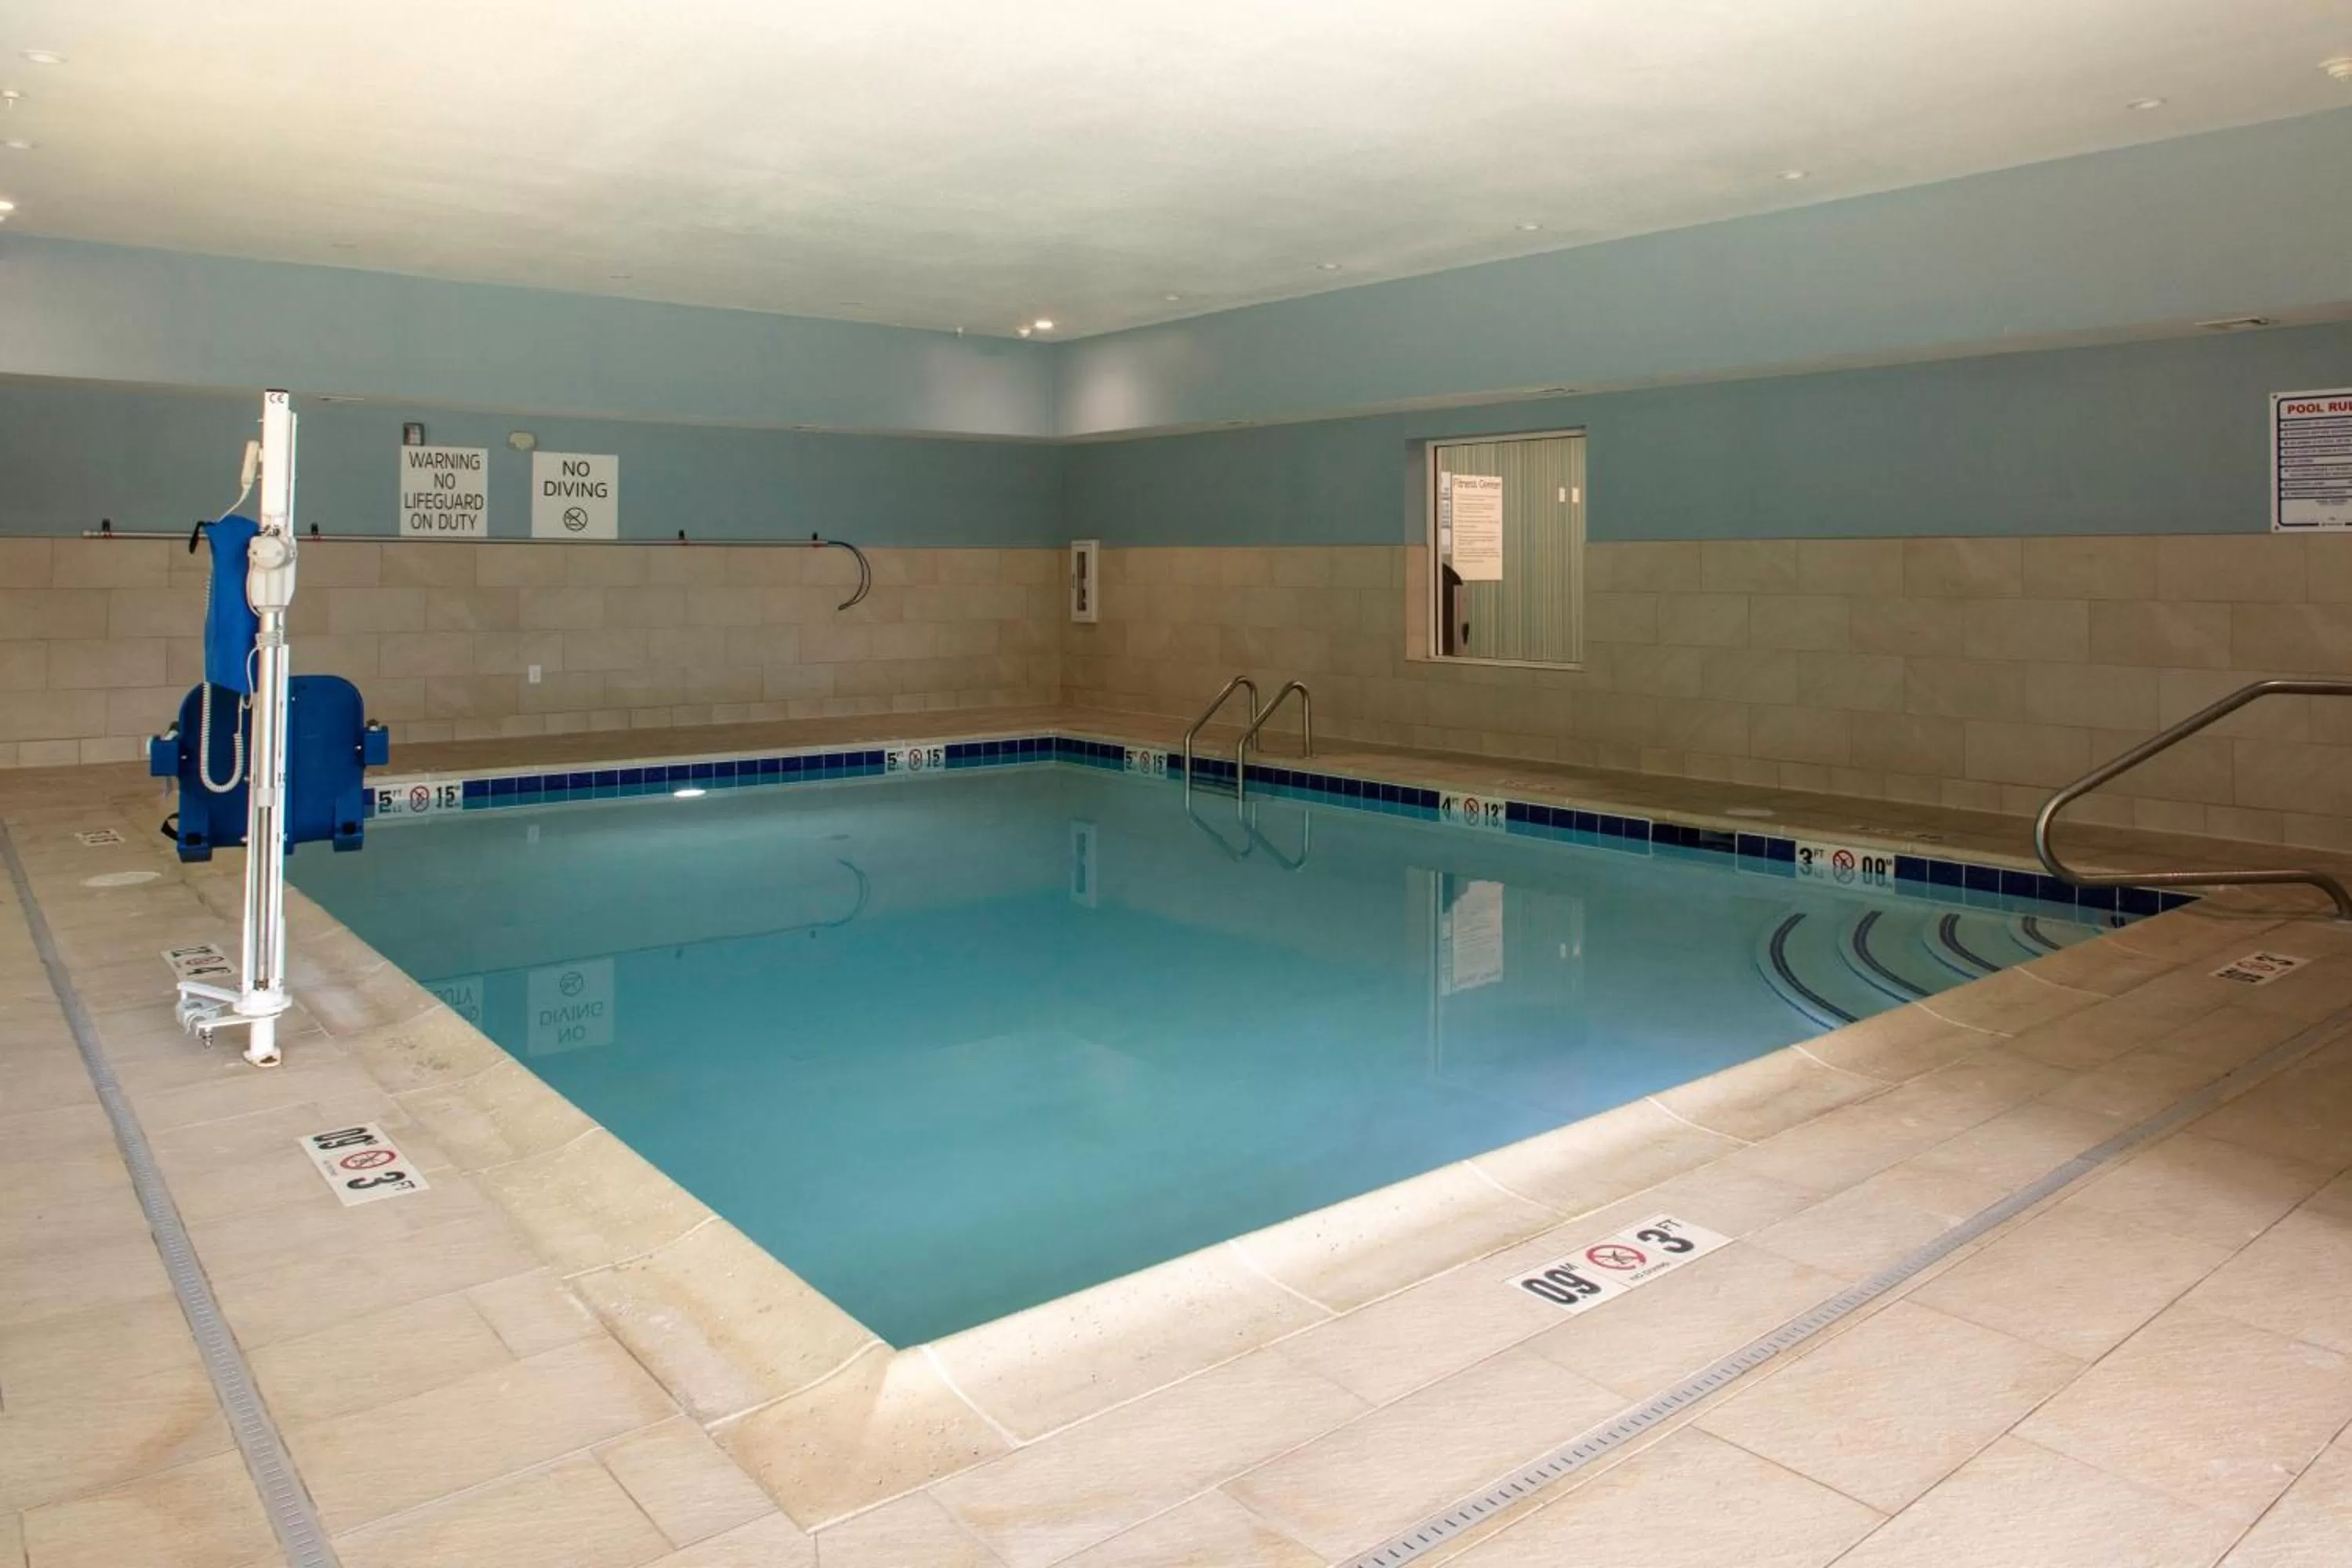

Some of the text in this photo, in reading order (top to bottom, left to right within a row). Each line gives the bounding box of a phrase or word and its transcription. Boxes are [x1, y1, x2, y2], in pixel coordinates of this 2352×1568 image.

[2288, 403, 2325, 414] POOL
[408, 452, 481, 470] WARNING
[562, 460, 590, 477] NO
[434, 474, 456, 489] NO
[543, 481, 608, 498] DIVING
[405, 492, 484, 510] LIFEGUARD
[410, 514, 477, 530] ON DUTY
[347, 1171, 407, 1189] 3
[1637, 1229, 1695, 1254] 3
